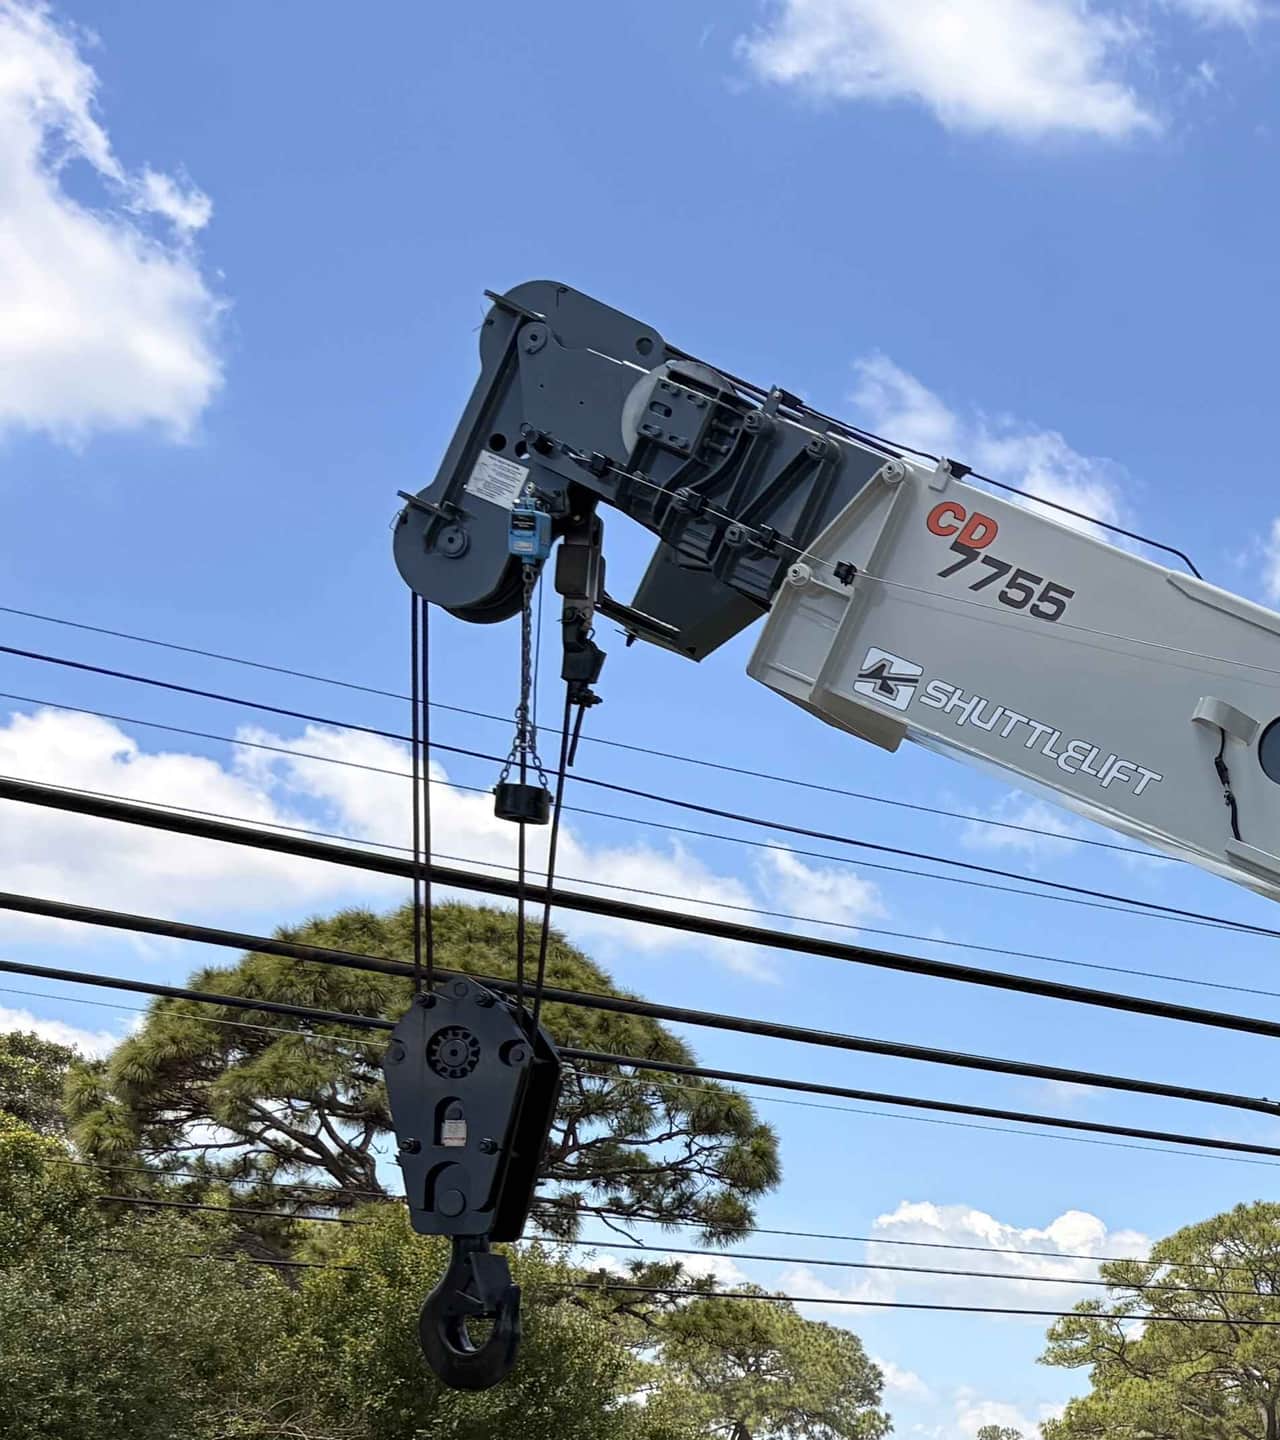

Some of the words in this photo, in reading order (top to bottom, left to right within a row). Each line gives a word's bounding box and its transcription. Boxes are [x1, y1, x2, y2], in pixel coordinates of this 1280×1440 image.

[926, 501, 999, 550] CD
[936, 539, 1076, 622] 7755
[919, 679, 1164, 796] SHUTTLELIFT
